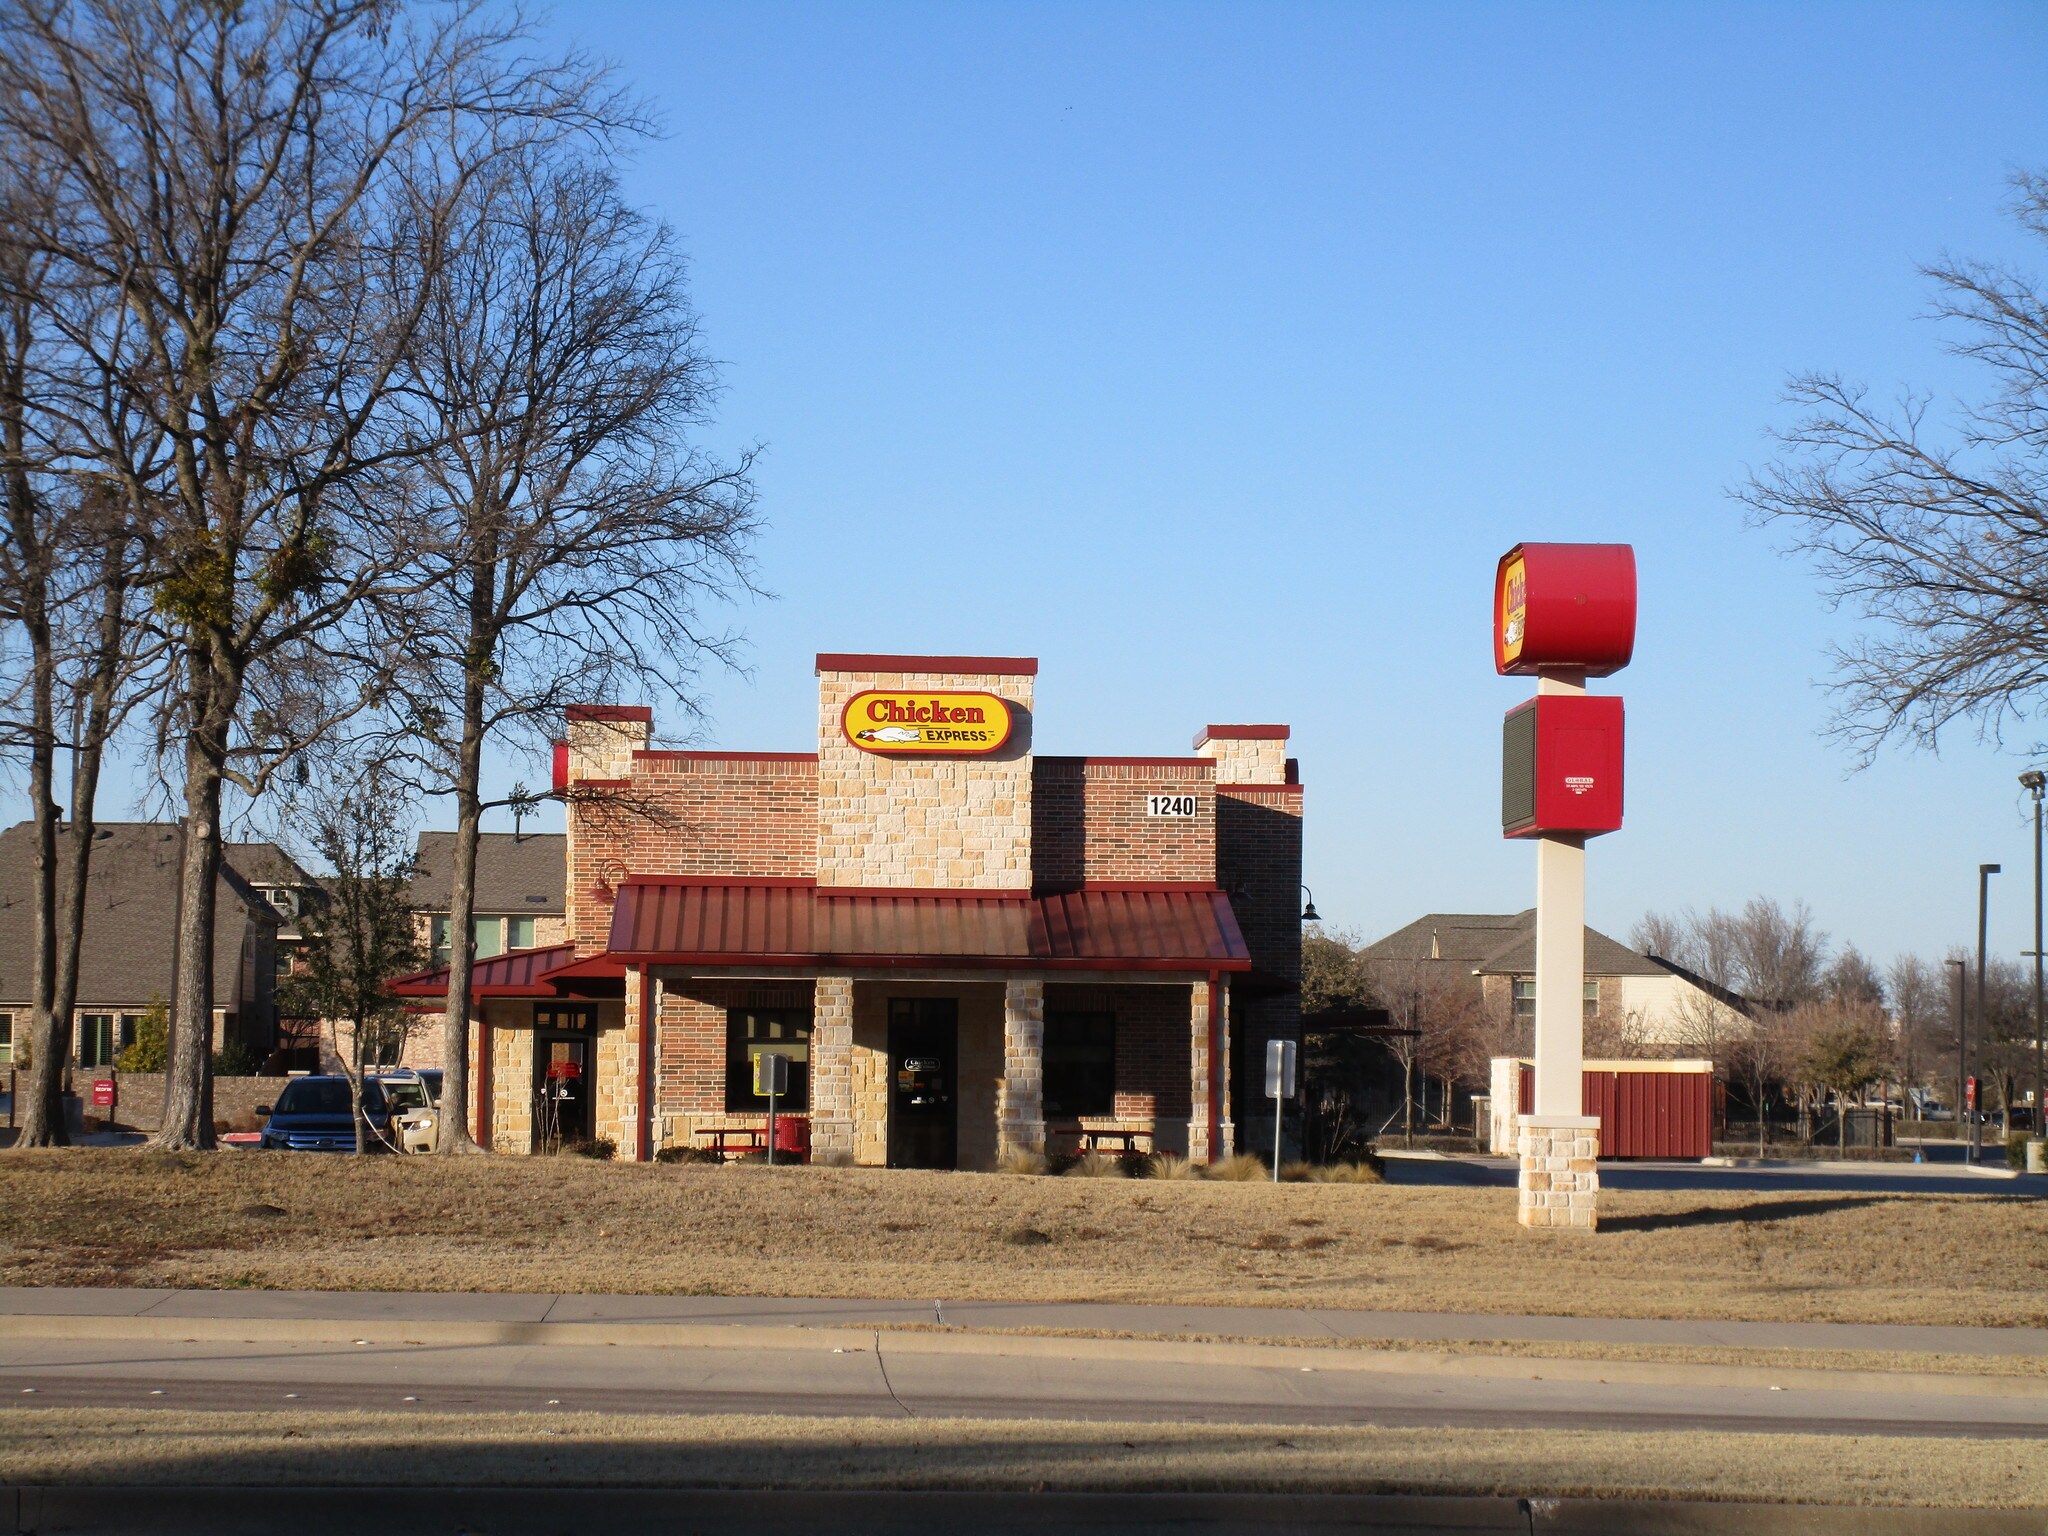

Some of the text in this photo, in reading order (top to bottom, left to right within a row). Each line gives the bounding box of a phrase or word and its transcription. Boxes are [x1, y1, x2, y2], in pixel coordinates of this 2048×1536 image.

[866, 699, 985, 724] Chicken
[926, 730, 987, 742] EXPRESS
[1150, 796, 1194, 816] 1240
